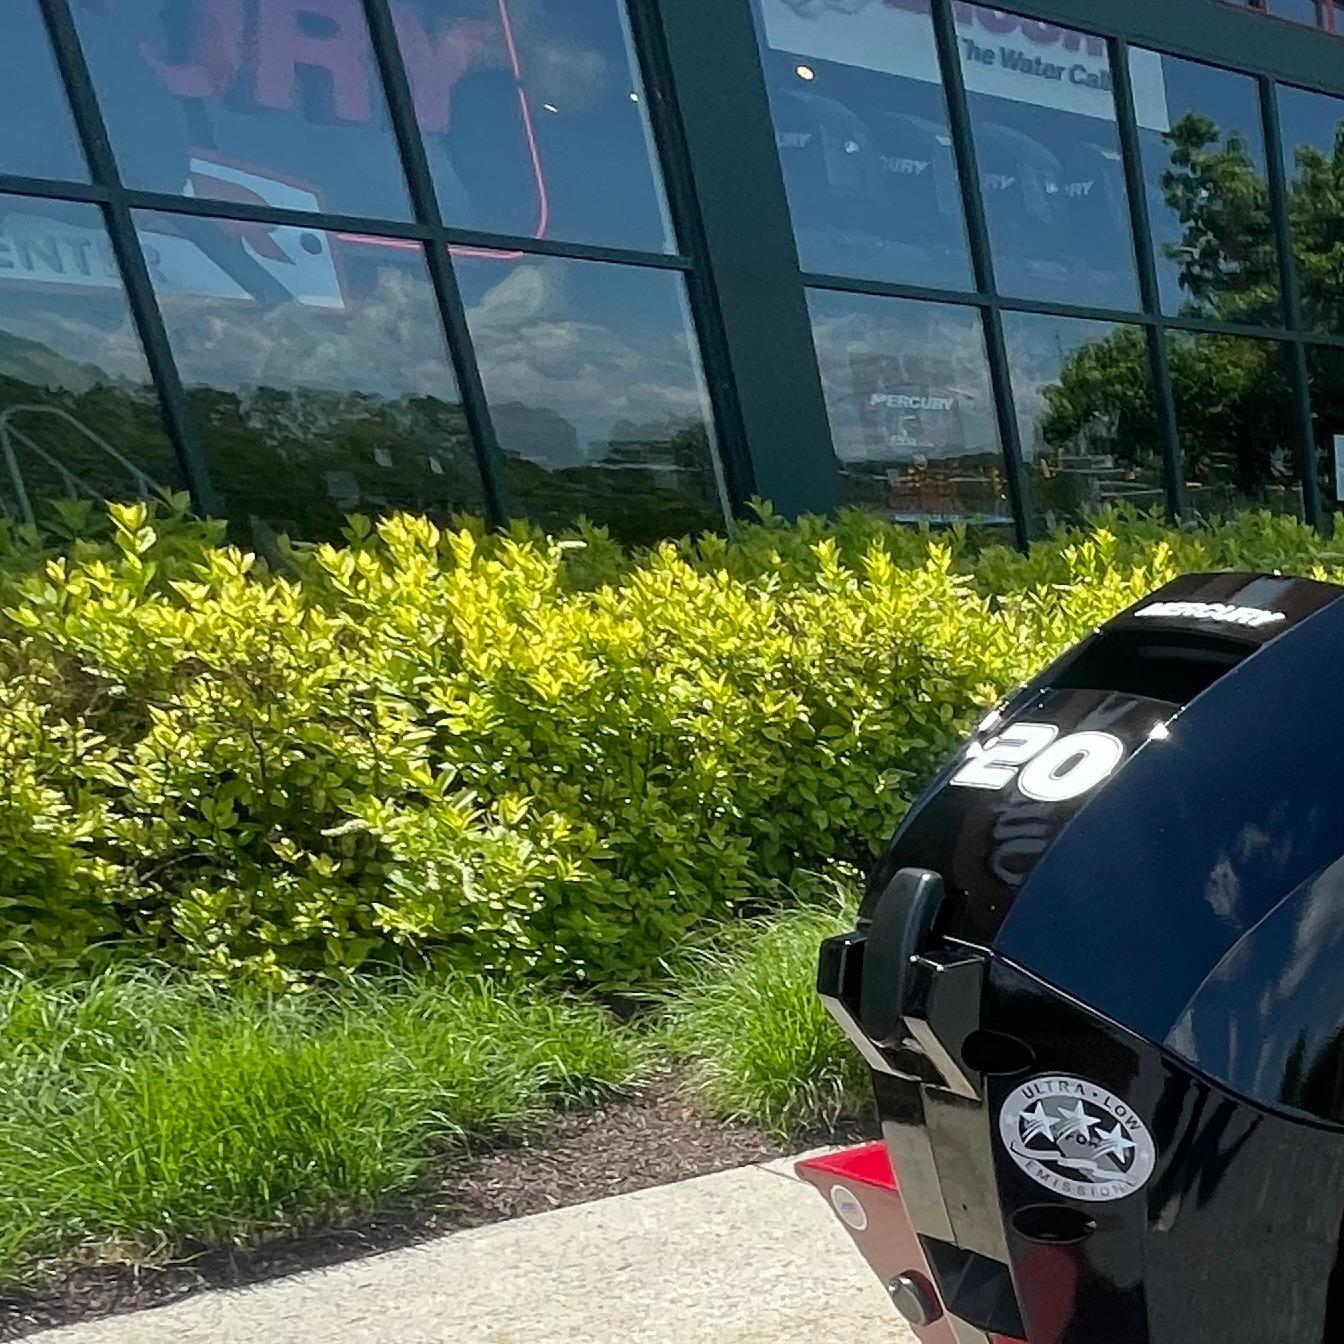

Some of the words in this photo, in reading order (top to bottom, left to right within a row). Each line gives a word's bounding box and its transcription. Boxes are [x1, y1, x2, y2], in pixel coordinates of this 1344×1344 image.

[1000, 46, 1064, 82] Water
[1134, 601, 1286, 628] MERCURY
[949, 721, 1124, 802] 20
[1021, 1080, 1086, 1099] ULTRA
[1102, 1095, 1142, 1131] LOW
